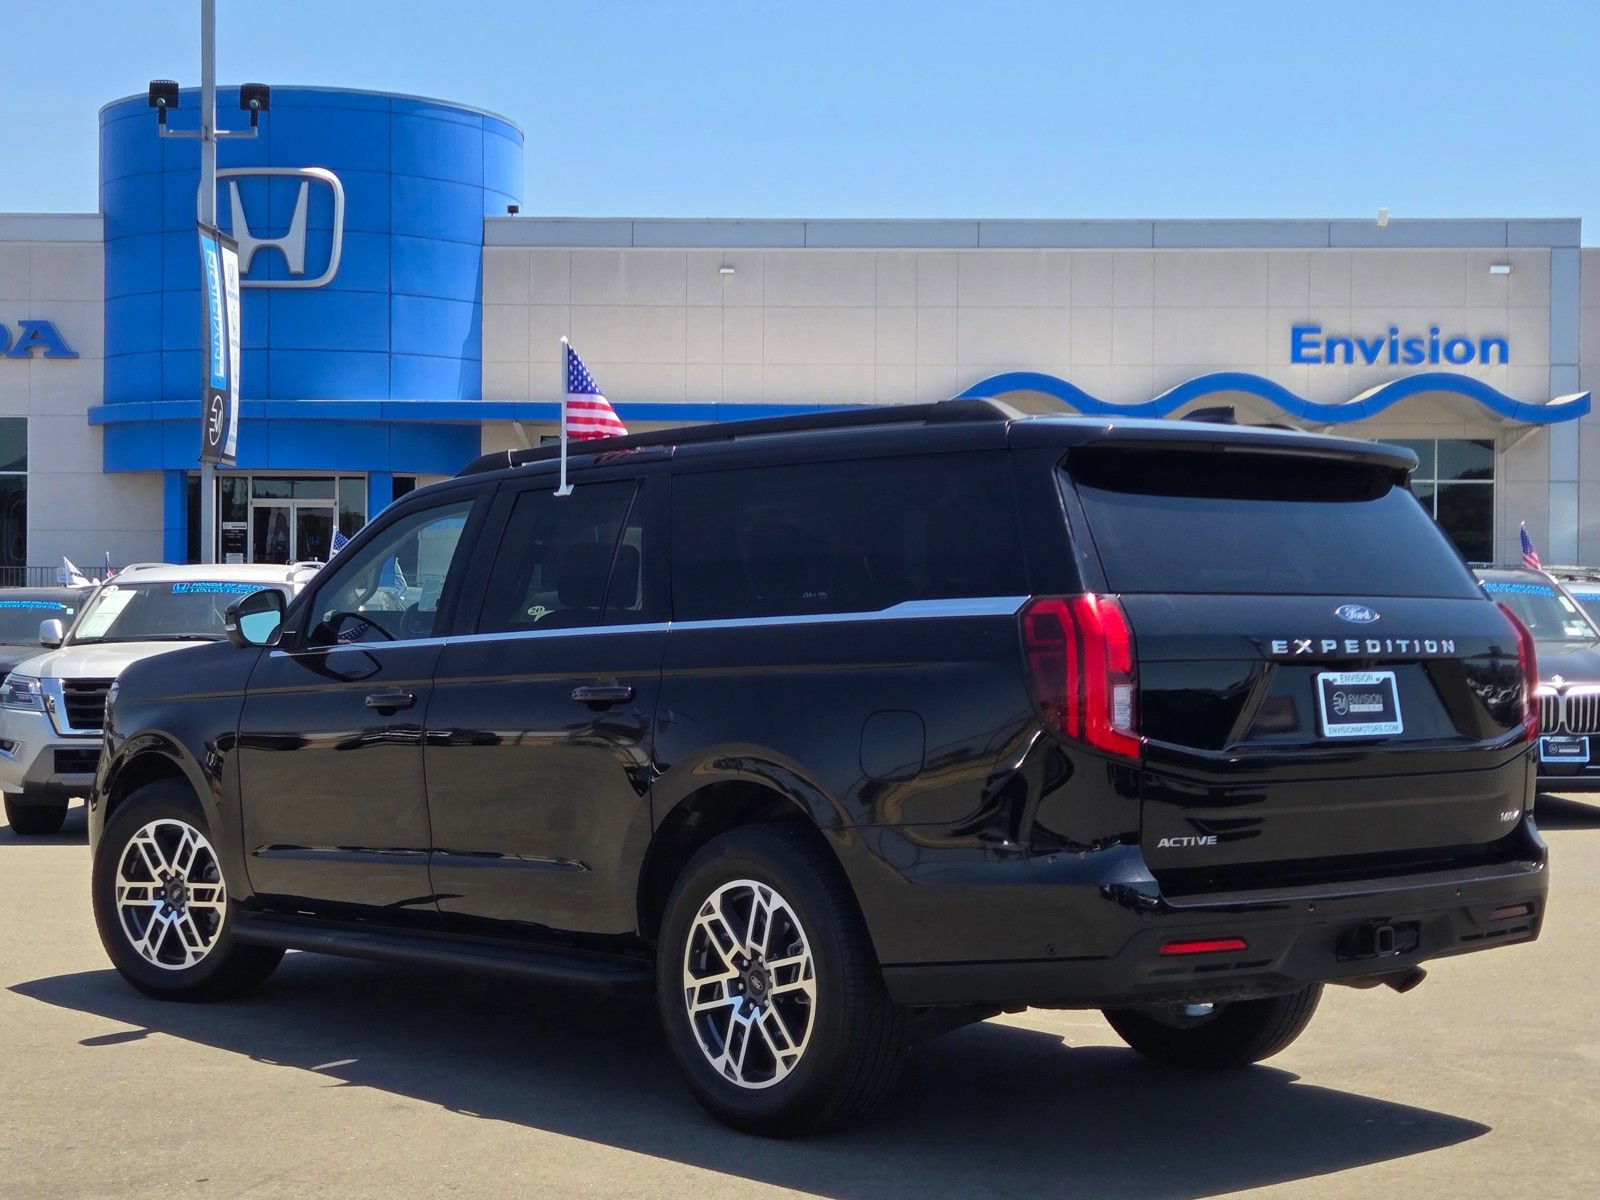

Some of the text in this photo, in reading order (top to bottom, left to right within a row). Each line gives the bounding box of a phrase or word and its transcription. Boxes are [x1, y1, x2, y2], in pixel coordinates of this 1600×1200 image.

[0, 320, 79, 359] A
[1290, 326, 1509, 365] Envision
[1344, 607, 1371, 620] Ford
[1271, 639, 1456, 654] EXPEDITION
[1340, 673, 1374, 683] ENVISION
[1348, 694, 1383, 704] ENVISION
[1157, 835, 1218, 848] ACTIVE
